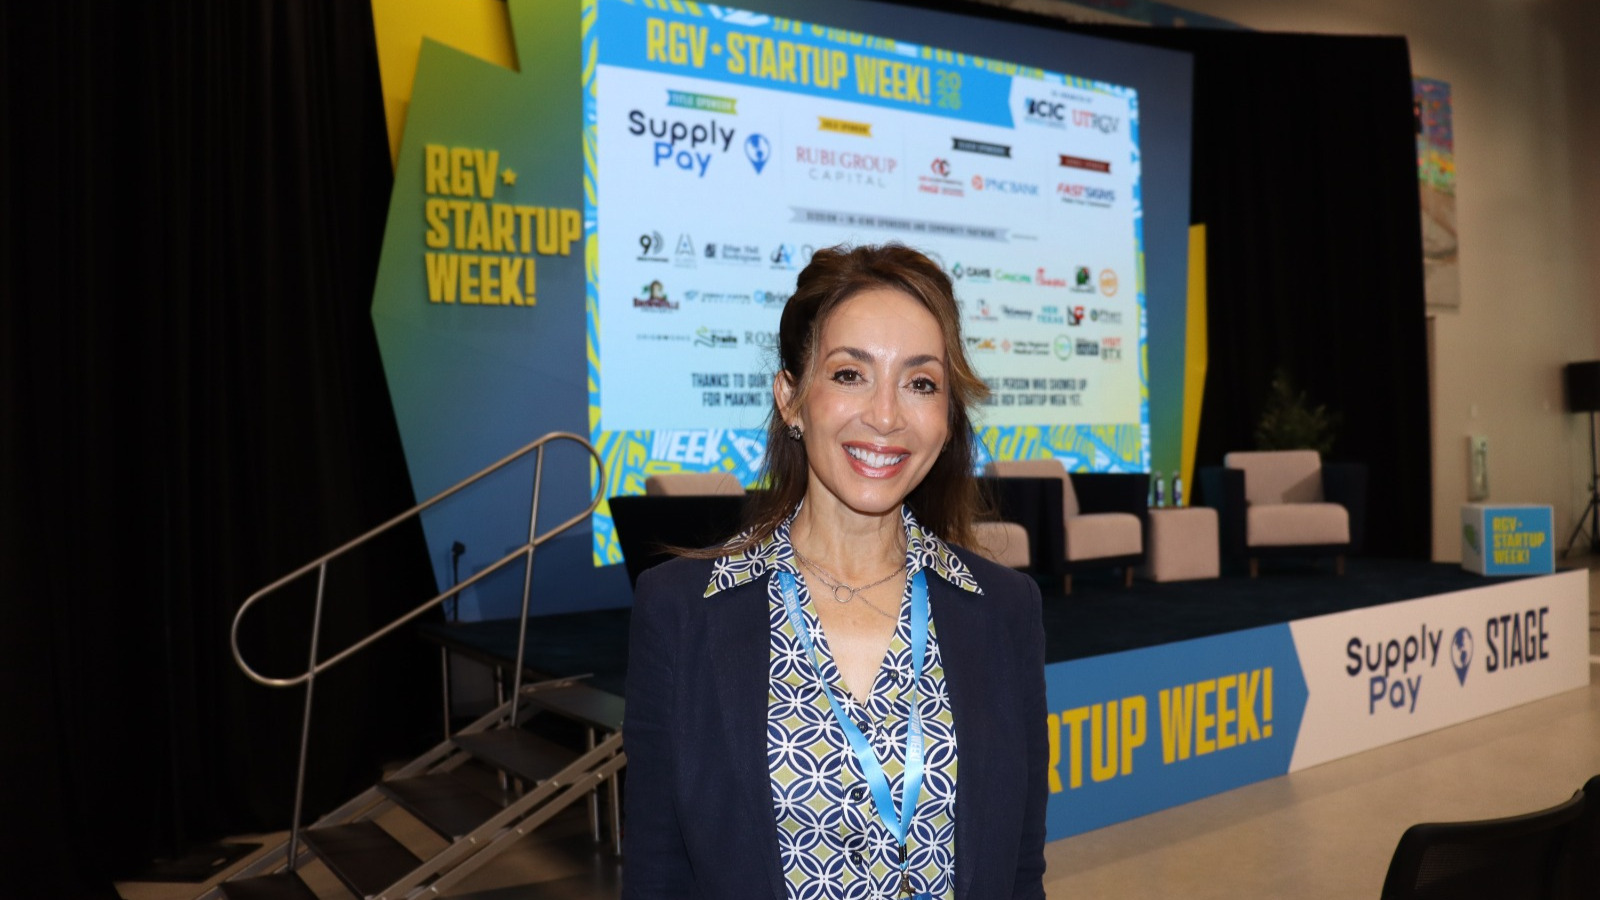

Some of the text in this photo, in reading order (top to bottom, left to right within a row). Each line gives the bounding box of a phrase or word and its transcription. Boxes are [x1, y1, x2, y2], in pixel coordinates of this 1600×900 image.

[646, 17, 931, 106] RGV STARTUP WEEK!
[936, 70, 962, 92] 20
[627, 109, 736, 154] Supply
[425, 143, 500, 200] RGV
[654, 141, 712, 179] Pay
[795, 145, 898, 174] RUBI GROUP
[808, 168, 887, 189] CAPITAL
[1056, 182, 1116, 202] FASTSIGNS
[425, 198, 582, 256] STARTUP
[425, 252, 537, 306] WEEK!
[691, 372, 729, 388] THANKS
[733, 373, 744, 388] TO
[702, 392, 721, 406] FOR
[724, 392, 762, 407] MAKING
[650, 428, 723, 466] WEEK
[1492, 516, 1517, 532] RGV
[1493, 532, 1545, 548] STARTUP
[1493, 549, 1531, 565] WEEK!
[789, 611, 809, 646] STARTUP
[1486, 606, 1550, 674] STAGE
[1346, 622, 1444, 678] Supply
[1369, 674, 1422, 716] Pay
[1047, 666, 1273, 794] RTUP WEEK!
